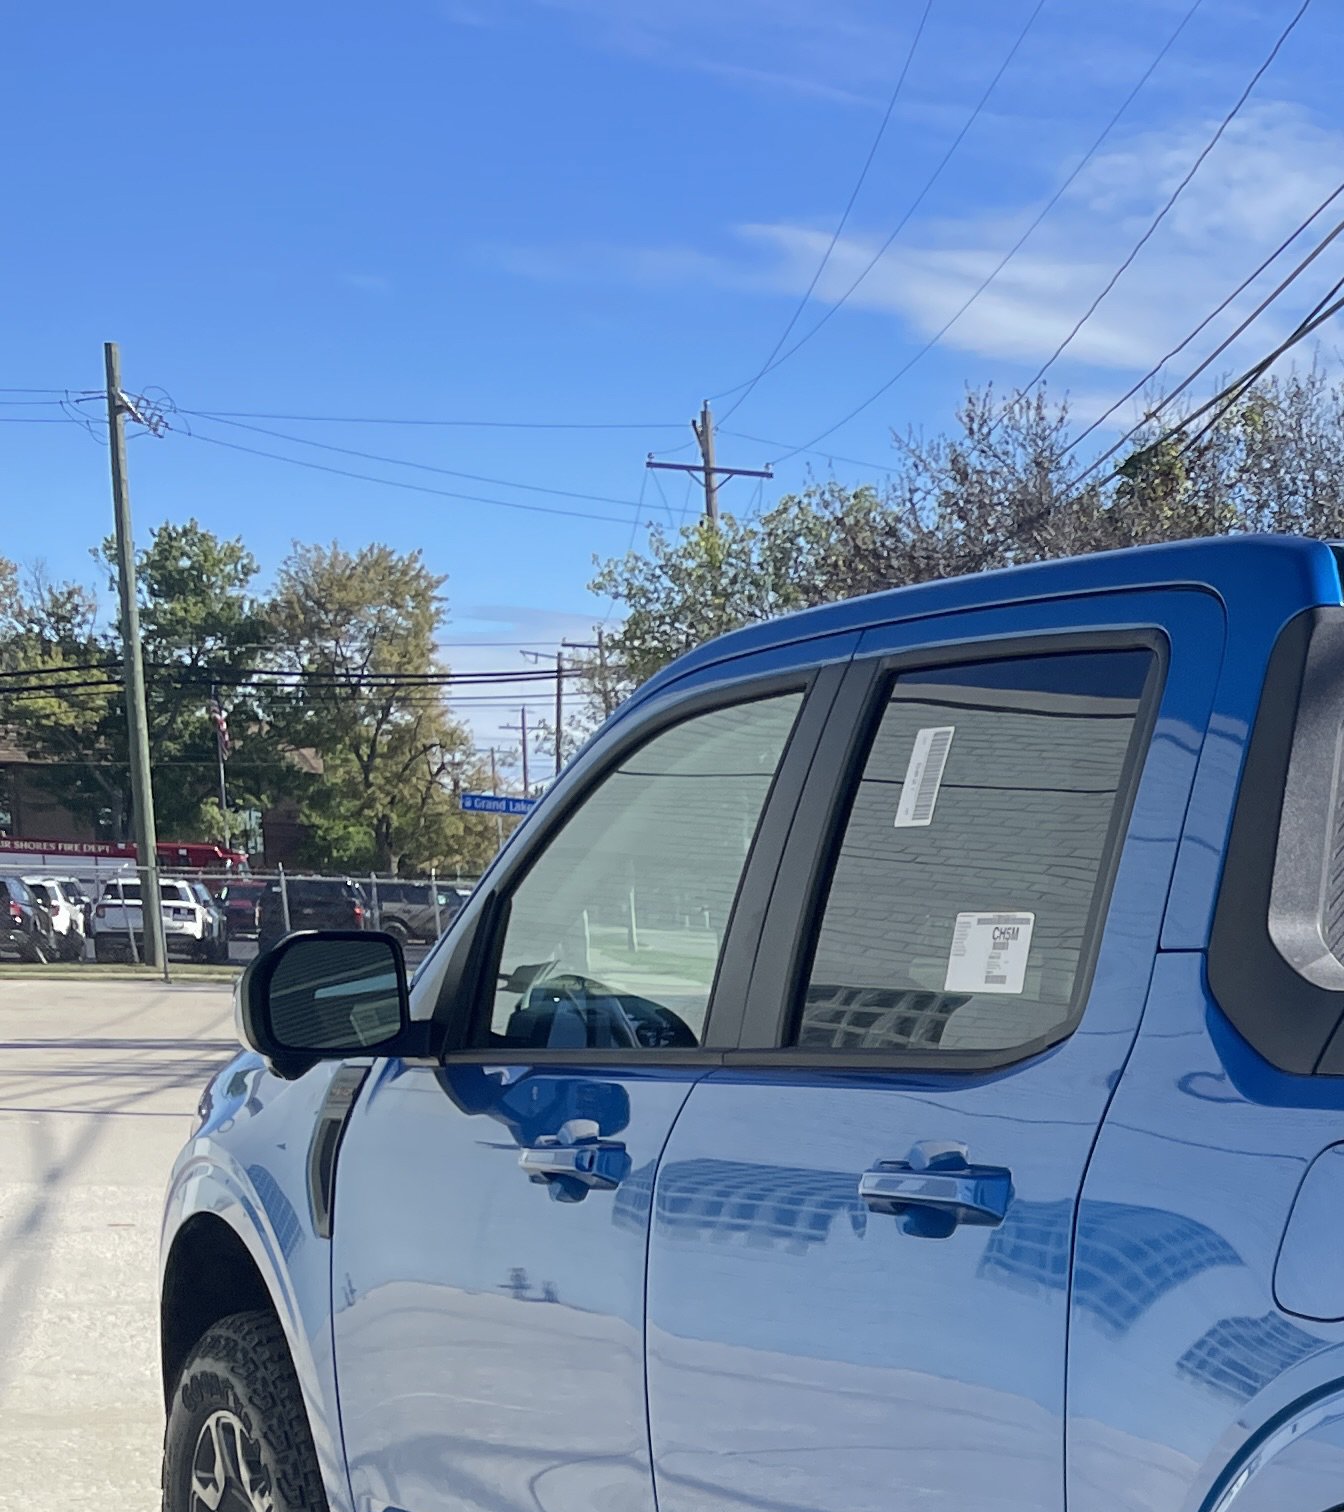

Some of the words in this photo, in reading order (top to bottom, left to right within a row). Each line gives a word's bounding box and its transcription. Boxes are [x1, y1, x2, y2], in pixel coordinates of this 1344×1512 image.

[474, 798, 506, 811] Grand
[14, 840, 56, 851] SHORES
[58, 842, 80, 852] FIRE
